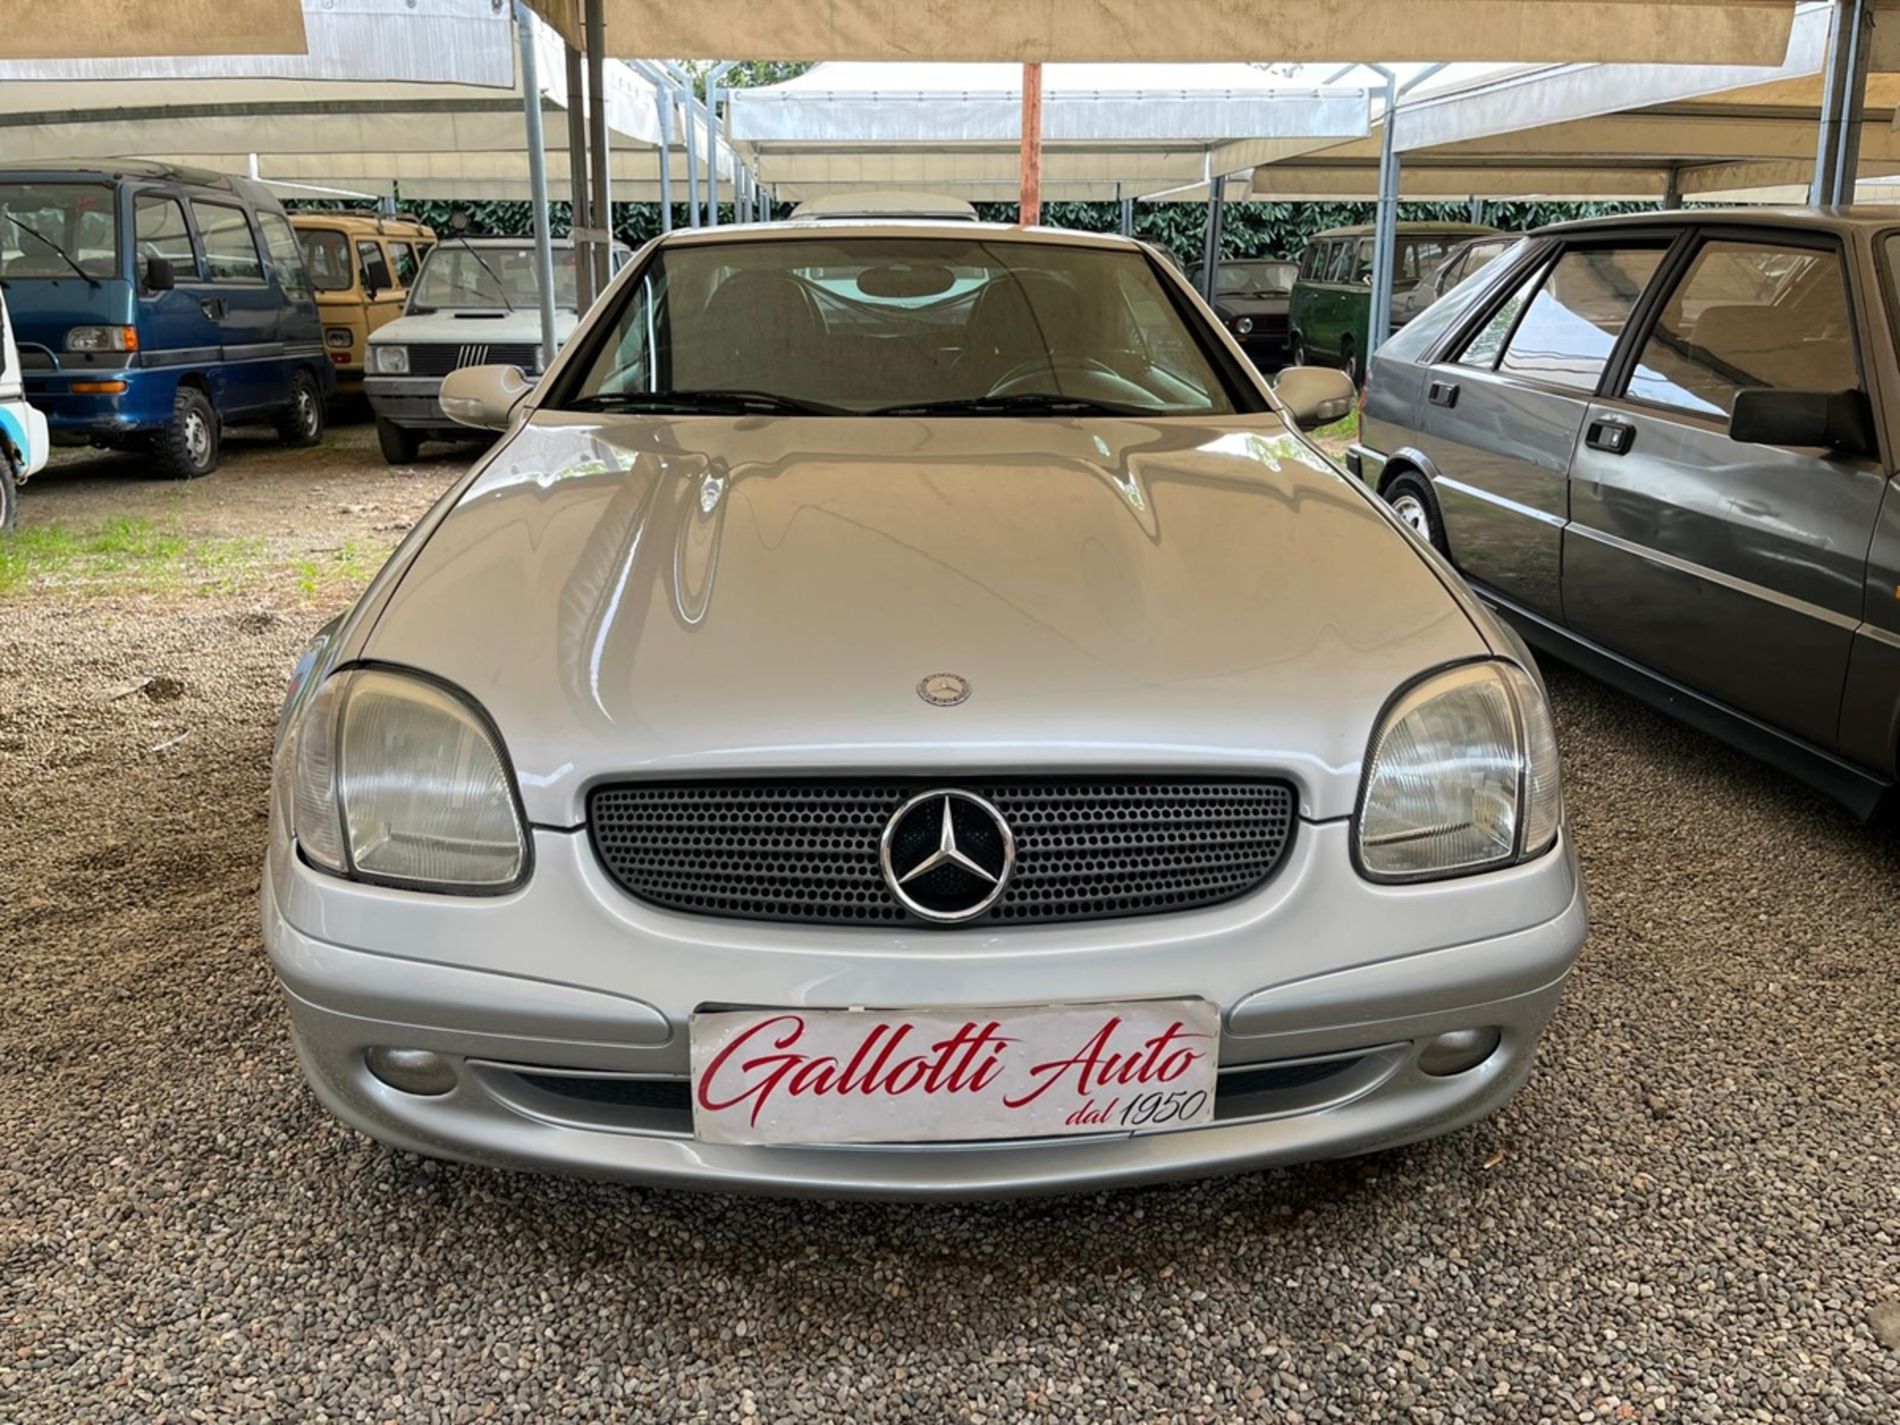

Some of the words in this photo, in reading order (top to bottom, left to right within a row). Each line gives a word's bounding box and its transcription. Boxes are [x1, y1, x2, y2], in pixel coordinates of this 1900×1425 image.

[698, 1015, 1022, 1127] Gallotti
[1003, 1016, 1215, 1109] Auto
[1065, 1099, 1120, 1126] dal
[1119, 1090, 1208, 1126] 1950
